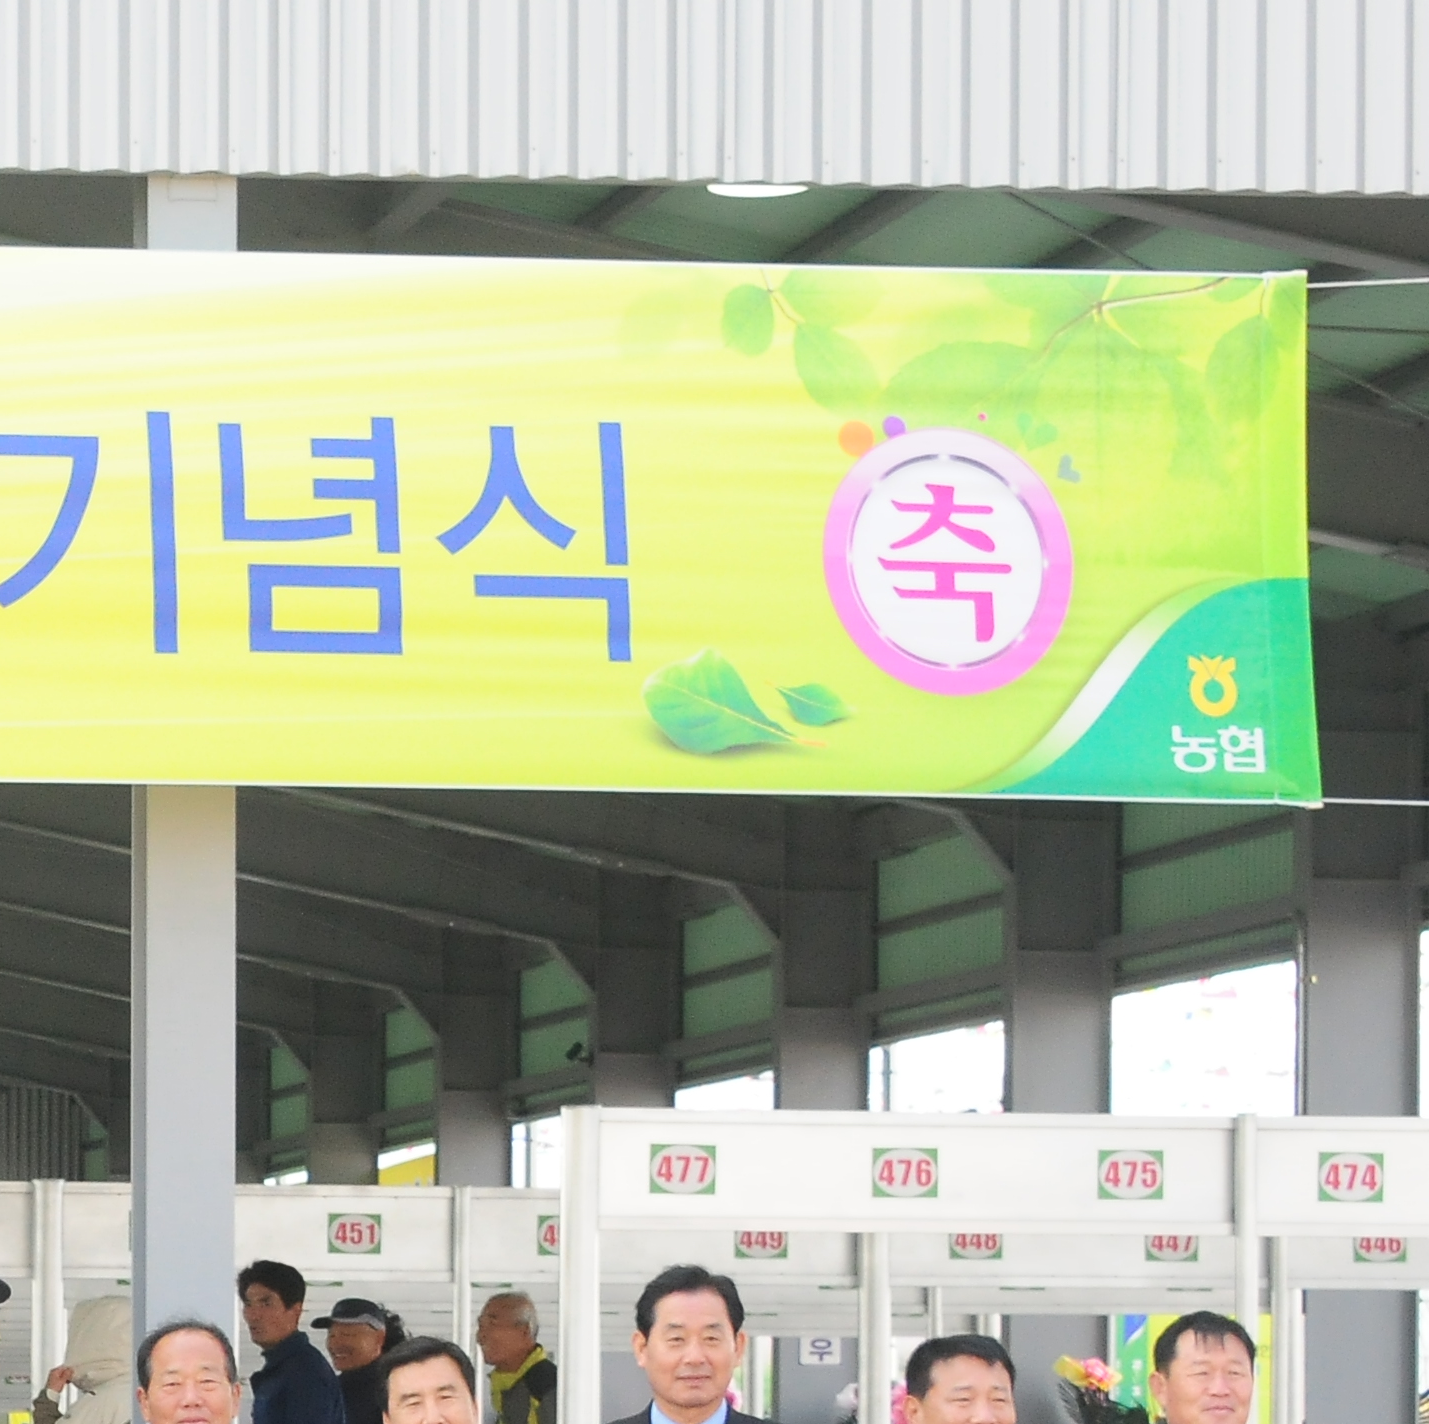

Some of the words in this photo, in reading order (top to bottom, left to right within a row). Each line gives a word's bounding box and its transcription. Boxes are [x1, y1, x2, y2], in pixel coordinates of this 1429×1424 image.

[877, 482, 1013, 644] 축
[1171, 724, 1267, 774] 농협
[655, 1154, 711, 1184] 477
[877, 1157, 934, 1188] 476
[1104, 1159, 1160, 1190] 475
[1323, 1162, 1379, 1192] 474
[334, 1221, 377, 1246] 451
[740, 1231, 785, 1250] 449
